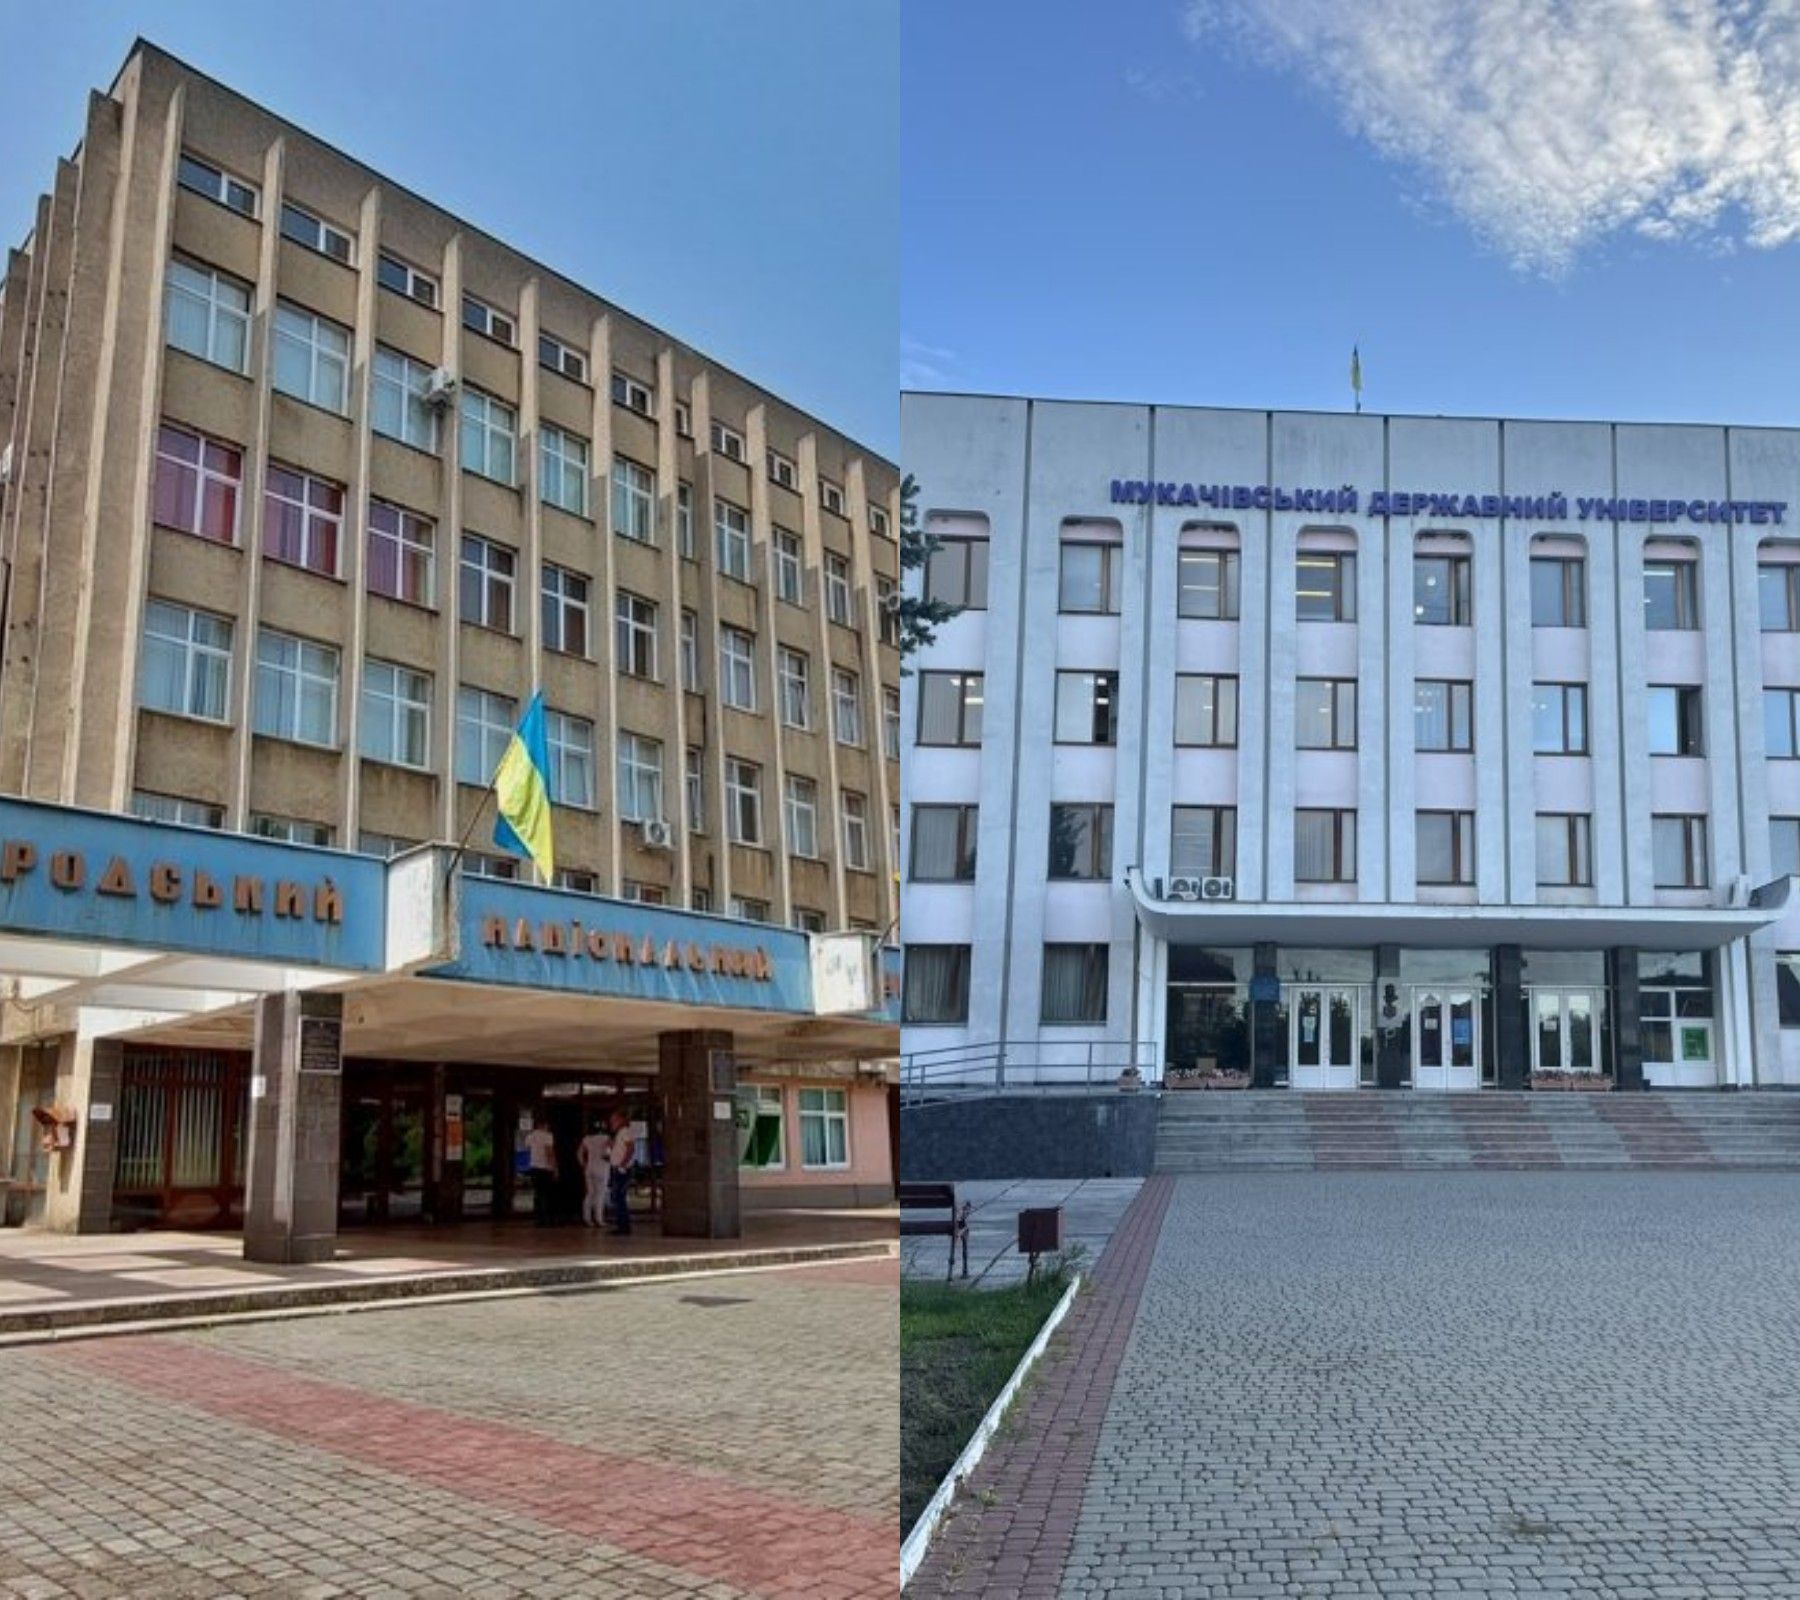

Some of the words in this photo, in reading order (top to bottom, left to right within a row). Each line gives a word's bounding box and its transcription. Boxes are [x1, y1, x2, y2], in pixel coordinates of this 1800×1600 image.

[1110, 480, 1358, 514] МУКАЧІВСЬКИЙ
[1368, 489, 1567, 520] ДЕРЖАВНИЙ
[1576, 497, 1787, 525] УНІВЕРСИТЕТ
[482, 913, 776, 981] НАЦІОНАЛЬНИЙ
